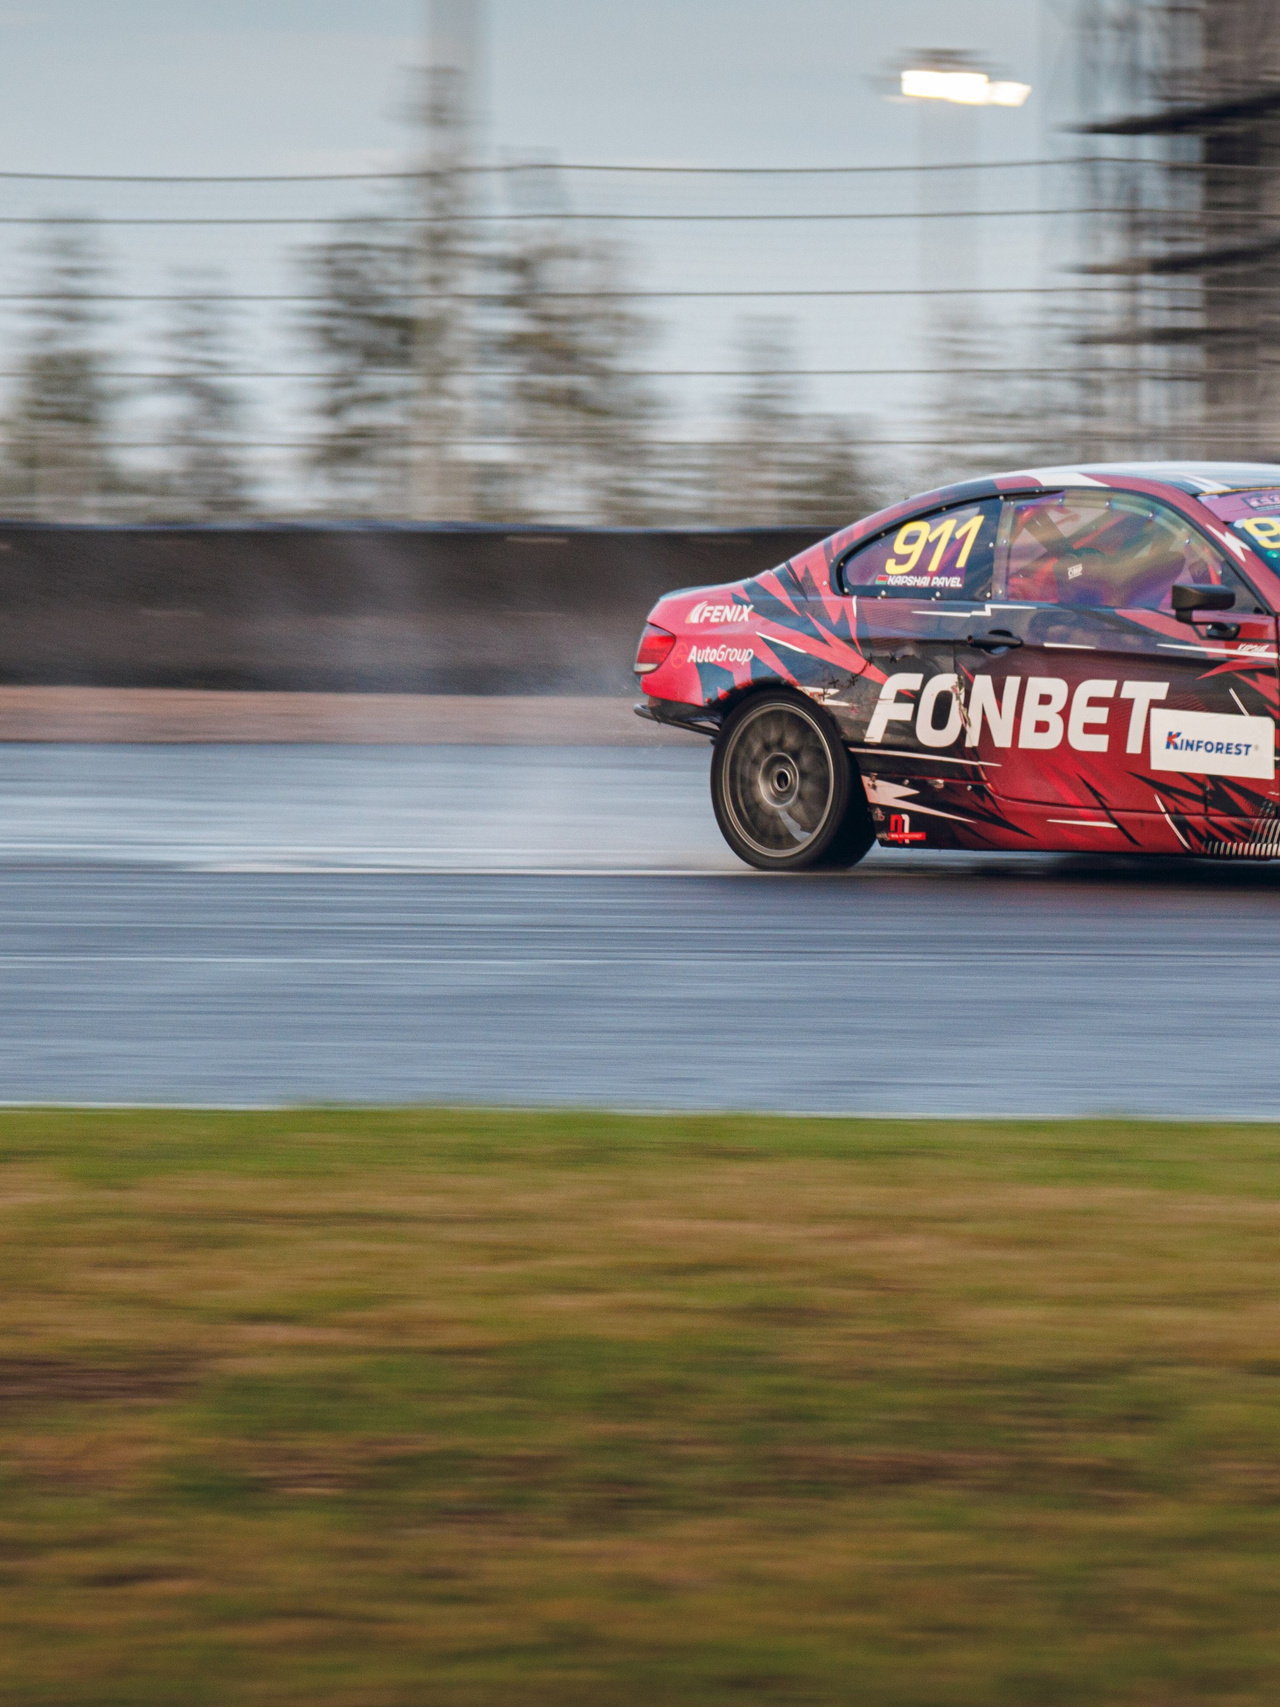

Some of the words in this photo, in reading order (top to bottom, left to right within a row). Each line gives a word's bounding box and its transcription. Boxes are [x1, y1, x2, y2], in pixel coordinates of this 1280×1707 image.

[885, 515, 985, 575] 911
[931, 577, 963, 588] PAVEL
[700, 604, 754, 623] FENIX
[687, 644, 754, 666] AutoGroup
[864, 673, 1170, 755] FONBET
[1165, 731, 1252, 757] KINFOREST
